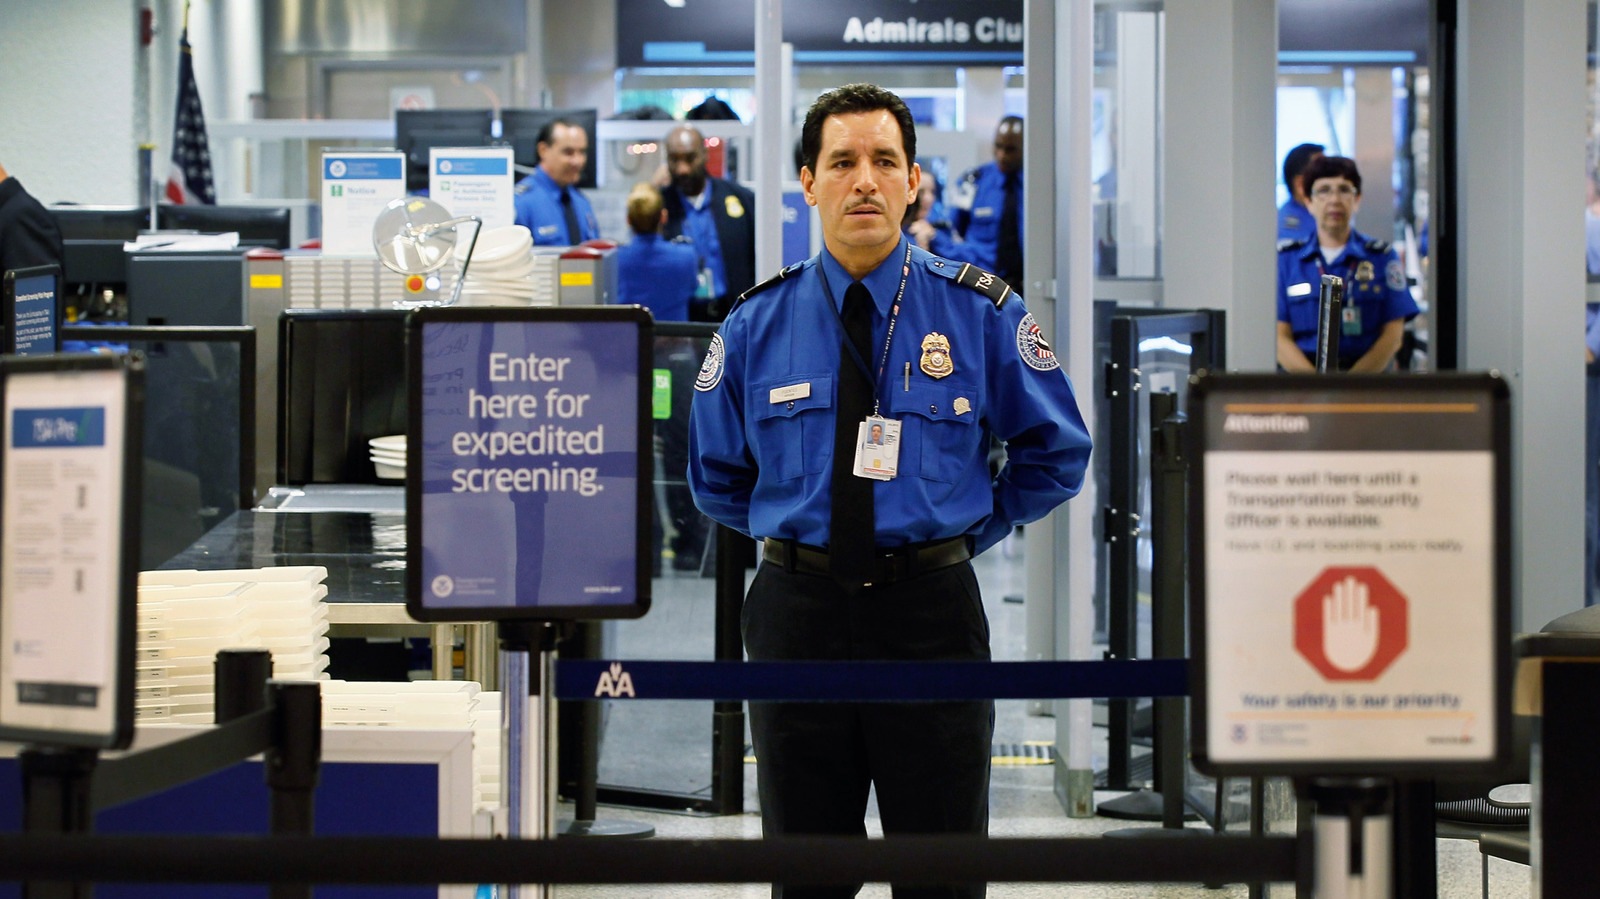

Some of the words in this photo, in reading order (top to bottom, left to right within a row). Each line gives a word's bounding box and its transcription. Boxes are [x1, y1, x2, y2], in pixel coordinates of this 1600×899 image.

[843, 17, 971, 43] Admirals
[975, 16, 1022, 43] Clu
[975, 272, 996, 290] TSA
[489, 352, 571, 382] Enter
[468, 388, 537, 418] here
[546, 388, 590, 418] for
[1224, 414, 1309, 433] Attention
[452, 424, 604, 460] expedited
[452, 461, 604, 497] screening.
[1226, 471, 1278, 486] Please
[1285, 471, 1318, 486] wait
[1327, 471, 1360, 486] here
[1368, 471, 1402, 486] until
[1409, 474, 1419, 486] a
[1226, 492, 1346, 509] Transportation
[1354, 492, 1421, 509] Security
[1226, 514, 1281, 529] Officer
[1289, 514, 1301, 529] is
[594, 670, 635, 697] AA
[1242, 694, 1279, 708] Your
[1285, 693, 1337, 711] safety
[1344, 693, 1357, 708] is
[1361, 696, 1388, 708] our
[1394, 693, 1462, 711] priority
